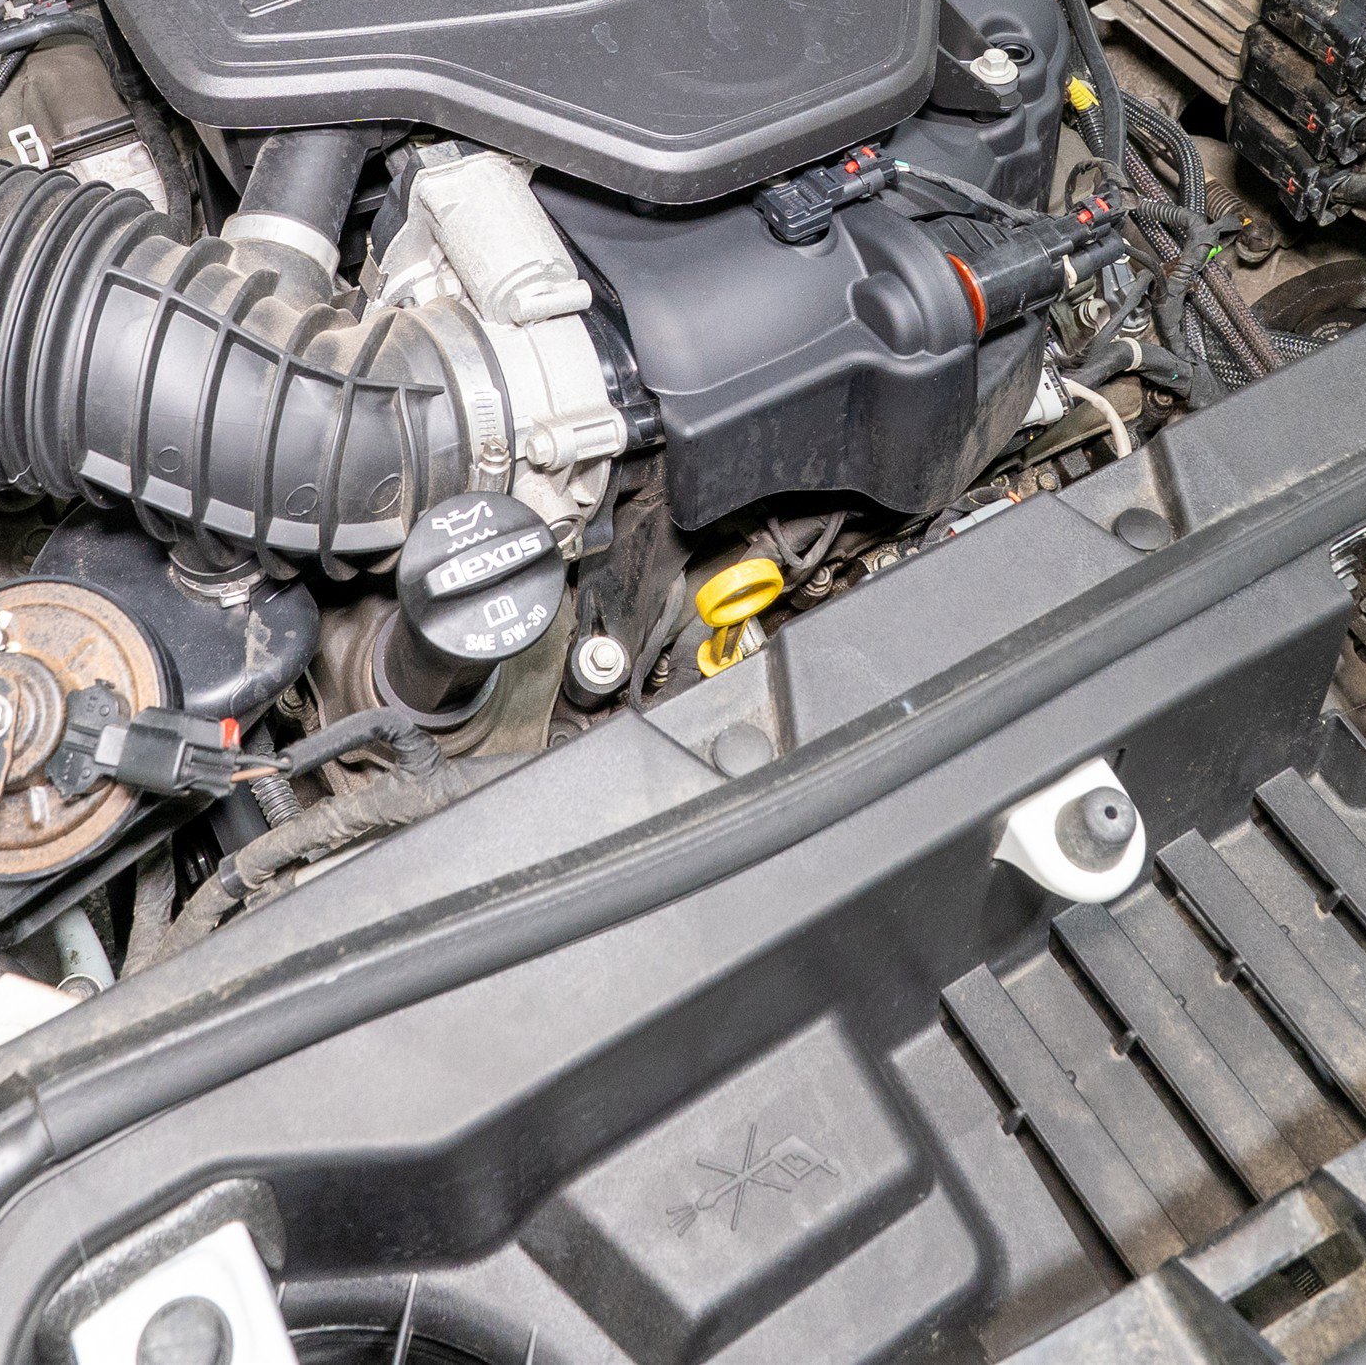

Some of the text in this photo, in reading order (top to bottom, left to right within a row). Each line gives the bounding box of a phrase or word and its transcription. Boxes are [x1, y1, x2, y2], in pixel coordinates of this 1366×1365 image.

[439, 532, 544, 590] dexos
[464, 603, 548, 652] SAE 5W-30
